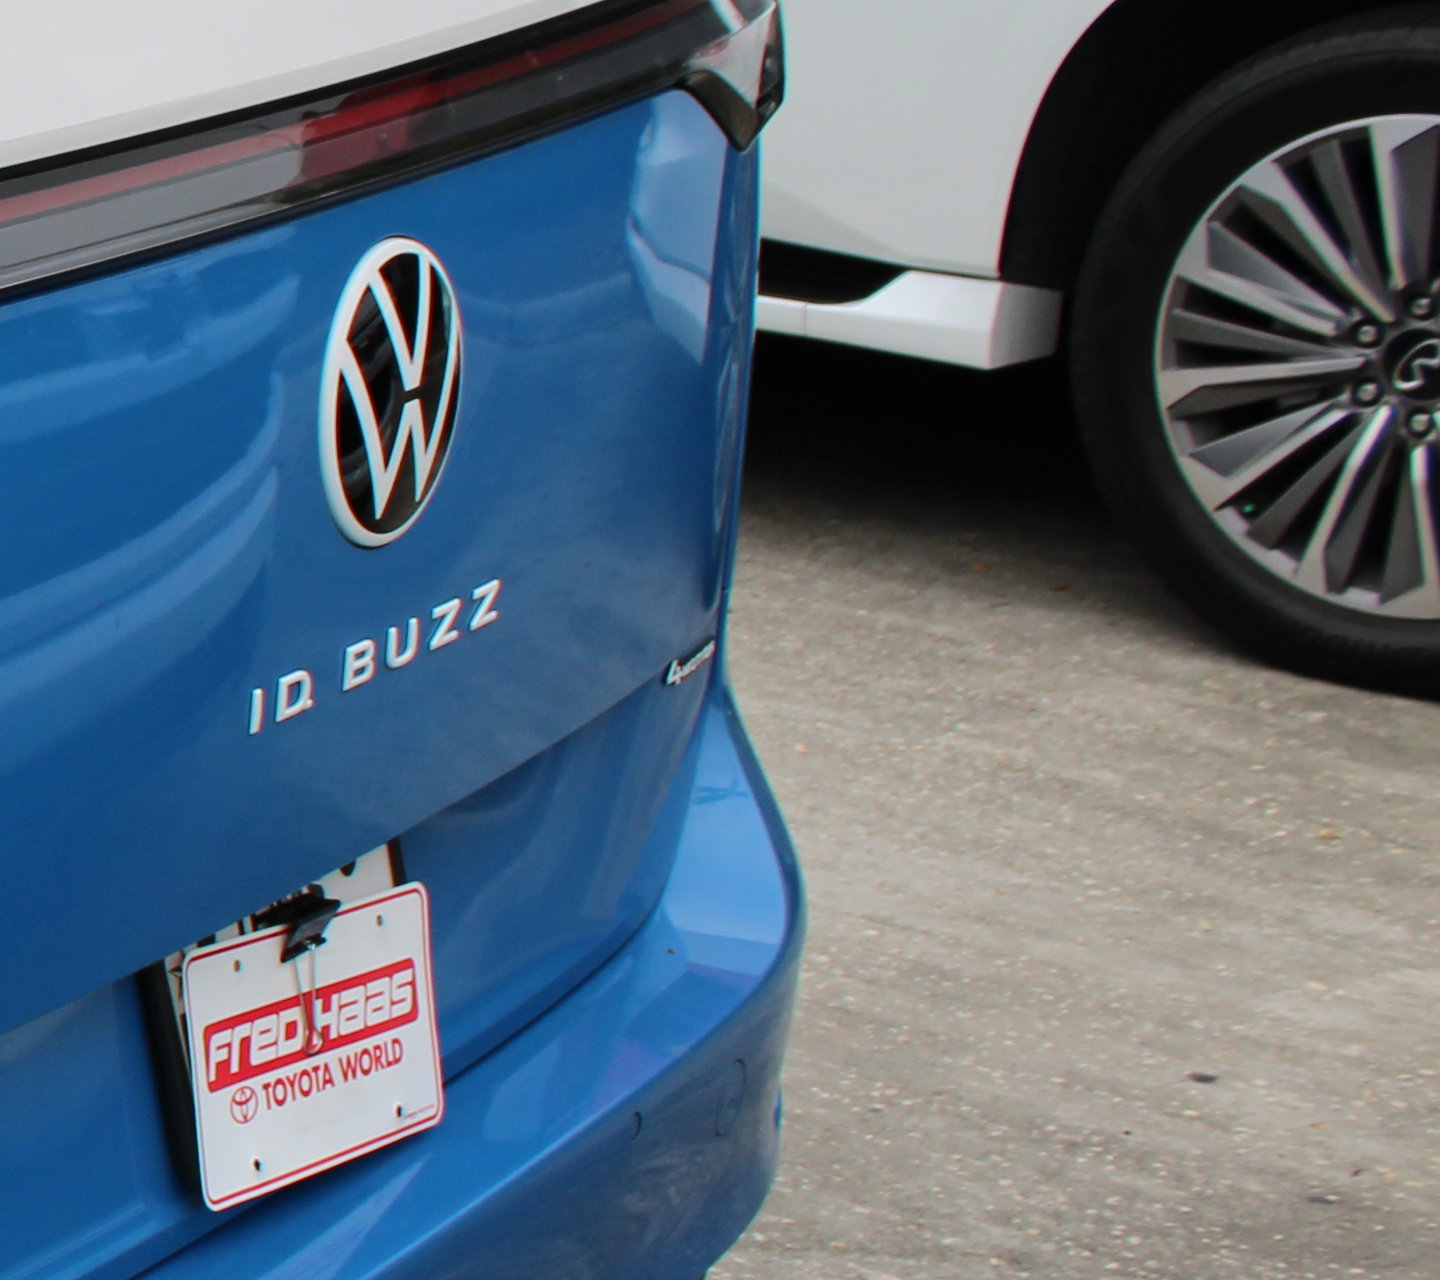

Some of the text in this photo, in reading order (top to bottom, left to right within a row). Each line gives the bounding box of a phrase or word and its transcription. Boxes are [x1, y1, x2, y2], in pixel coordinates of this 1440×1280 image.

[325, 245, 462, 535] VW
[341, 577, 504, 693] BUZZ
[262, 1037, 404, 1111] TOYOTA WORLD
